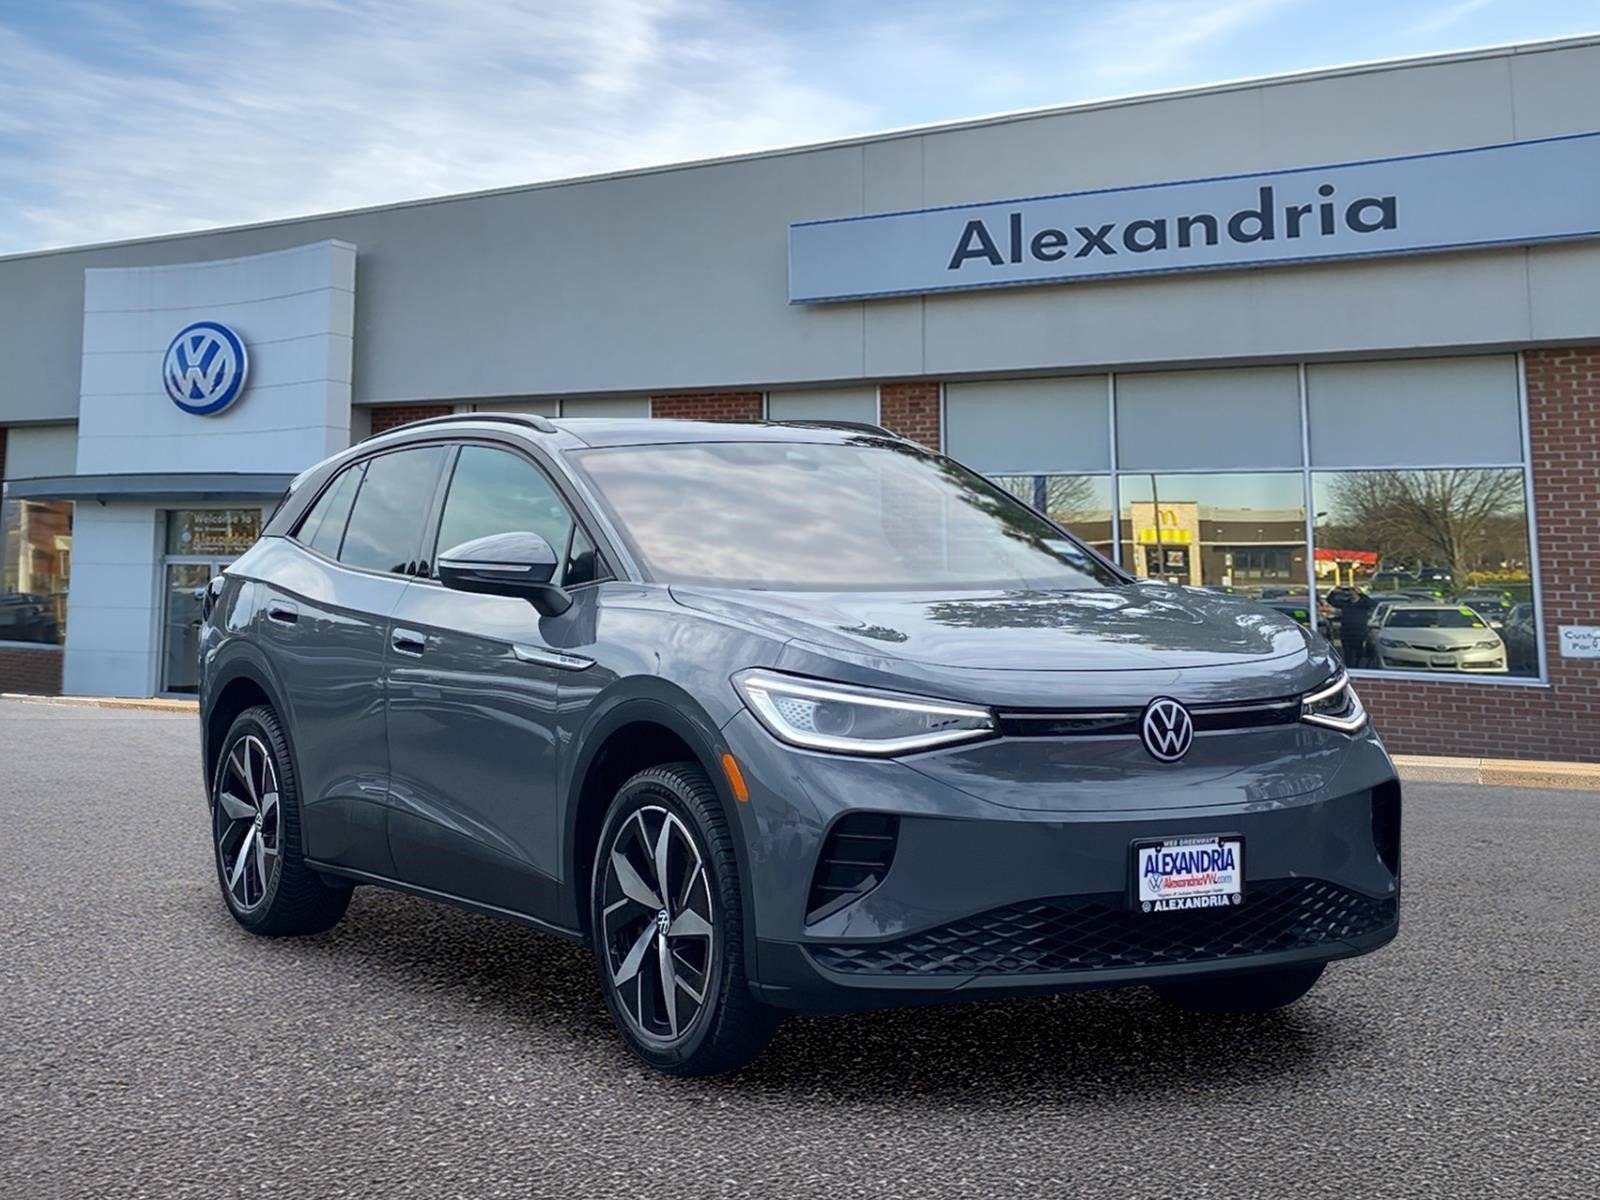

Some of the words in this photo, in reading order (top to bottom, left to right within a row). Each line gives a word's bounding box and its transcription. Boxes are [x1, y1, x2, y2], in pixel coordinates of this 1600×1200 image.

[947, 184, 1398, 270] Alexandria
[167, 331, 234, 404] VW
[1146, 702, 1190, 756] VW
[1144, 848, 1235, 877] ALEXANDRIA
[1154, 895, 1229, 911] ALEXANDRIA
